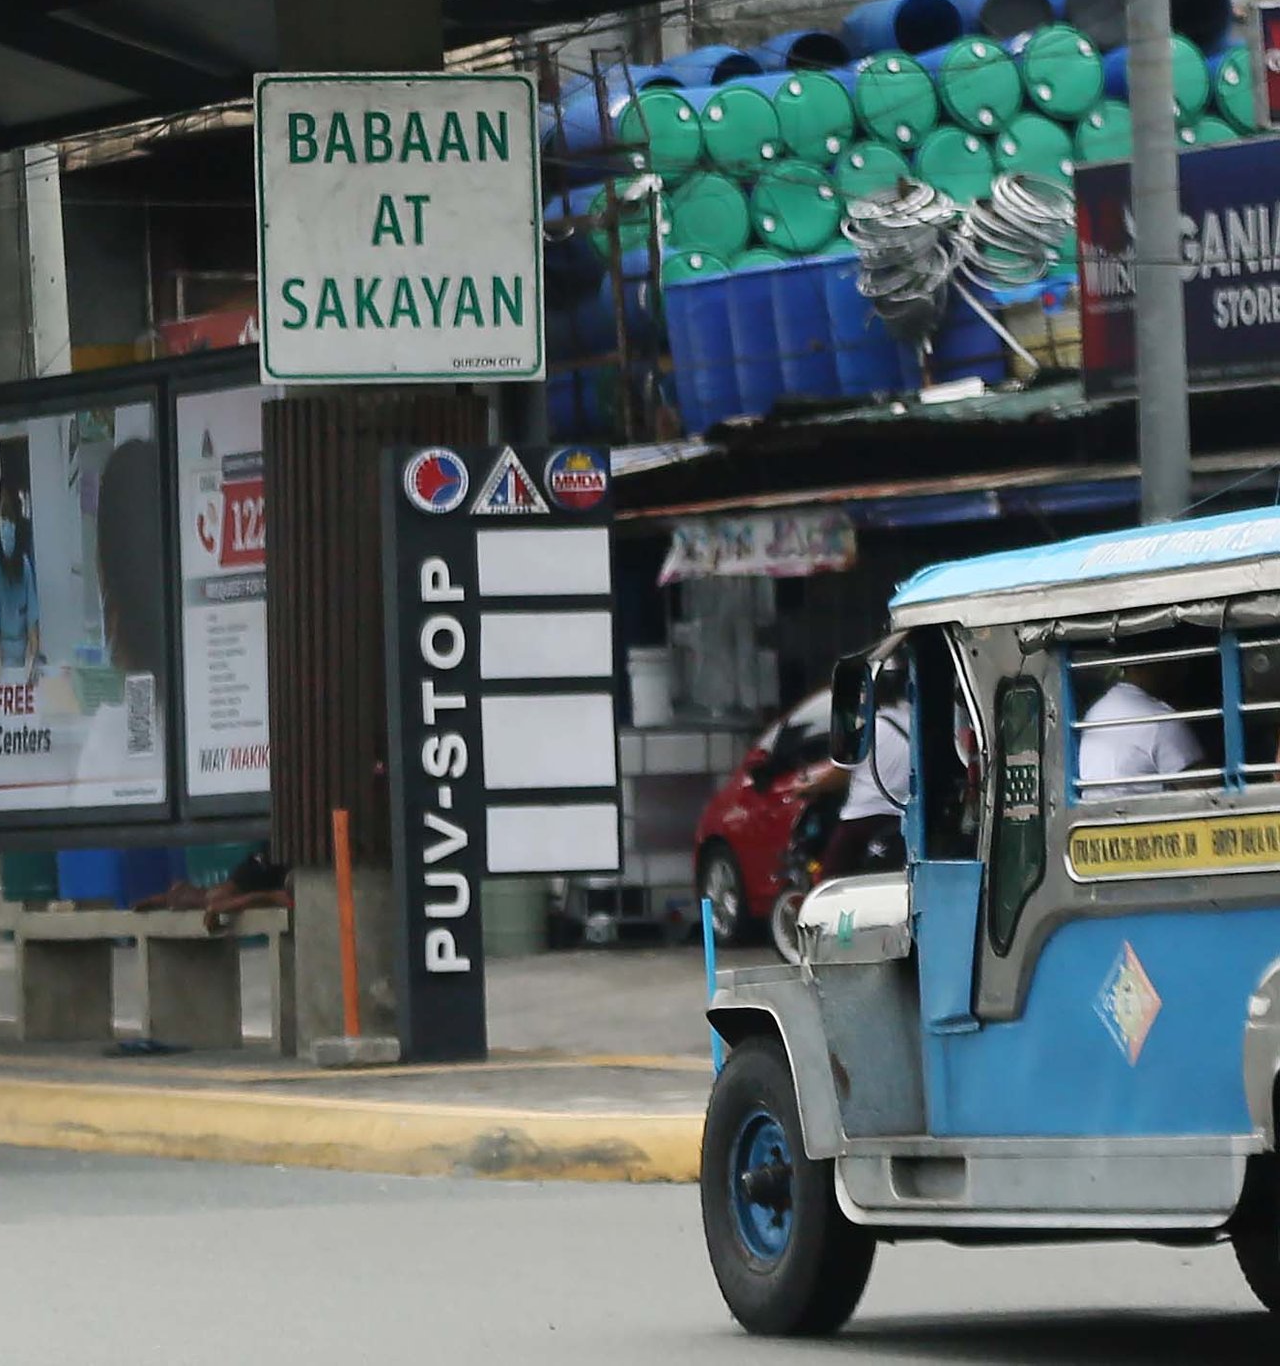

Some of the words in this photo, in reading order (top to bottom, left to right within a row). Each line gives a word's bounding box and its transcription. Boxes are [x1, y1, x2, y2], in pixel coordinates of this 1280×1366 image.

[288, 110, 509, 164] BABAAN
[371, 194, 431, 247] AT
[281, 275, 524, 330] SAKAYAN
[452, 358, 497, 369] QUEZON
[498, 357, 522, 368] CITY
[554, 473, 603, 489] MMDA
[419, 555, 472, 974] PUV-STOP
